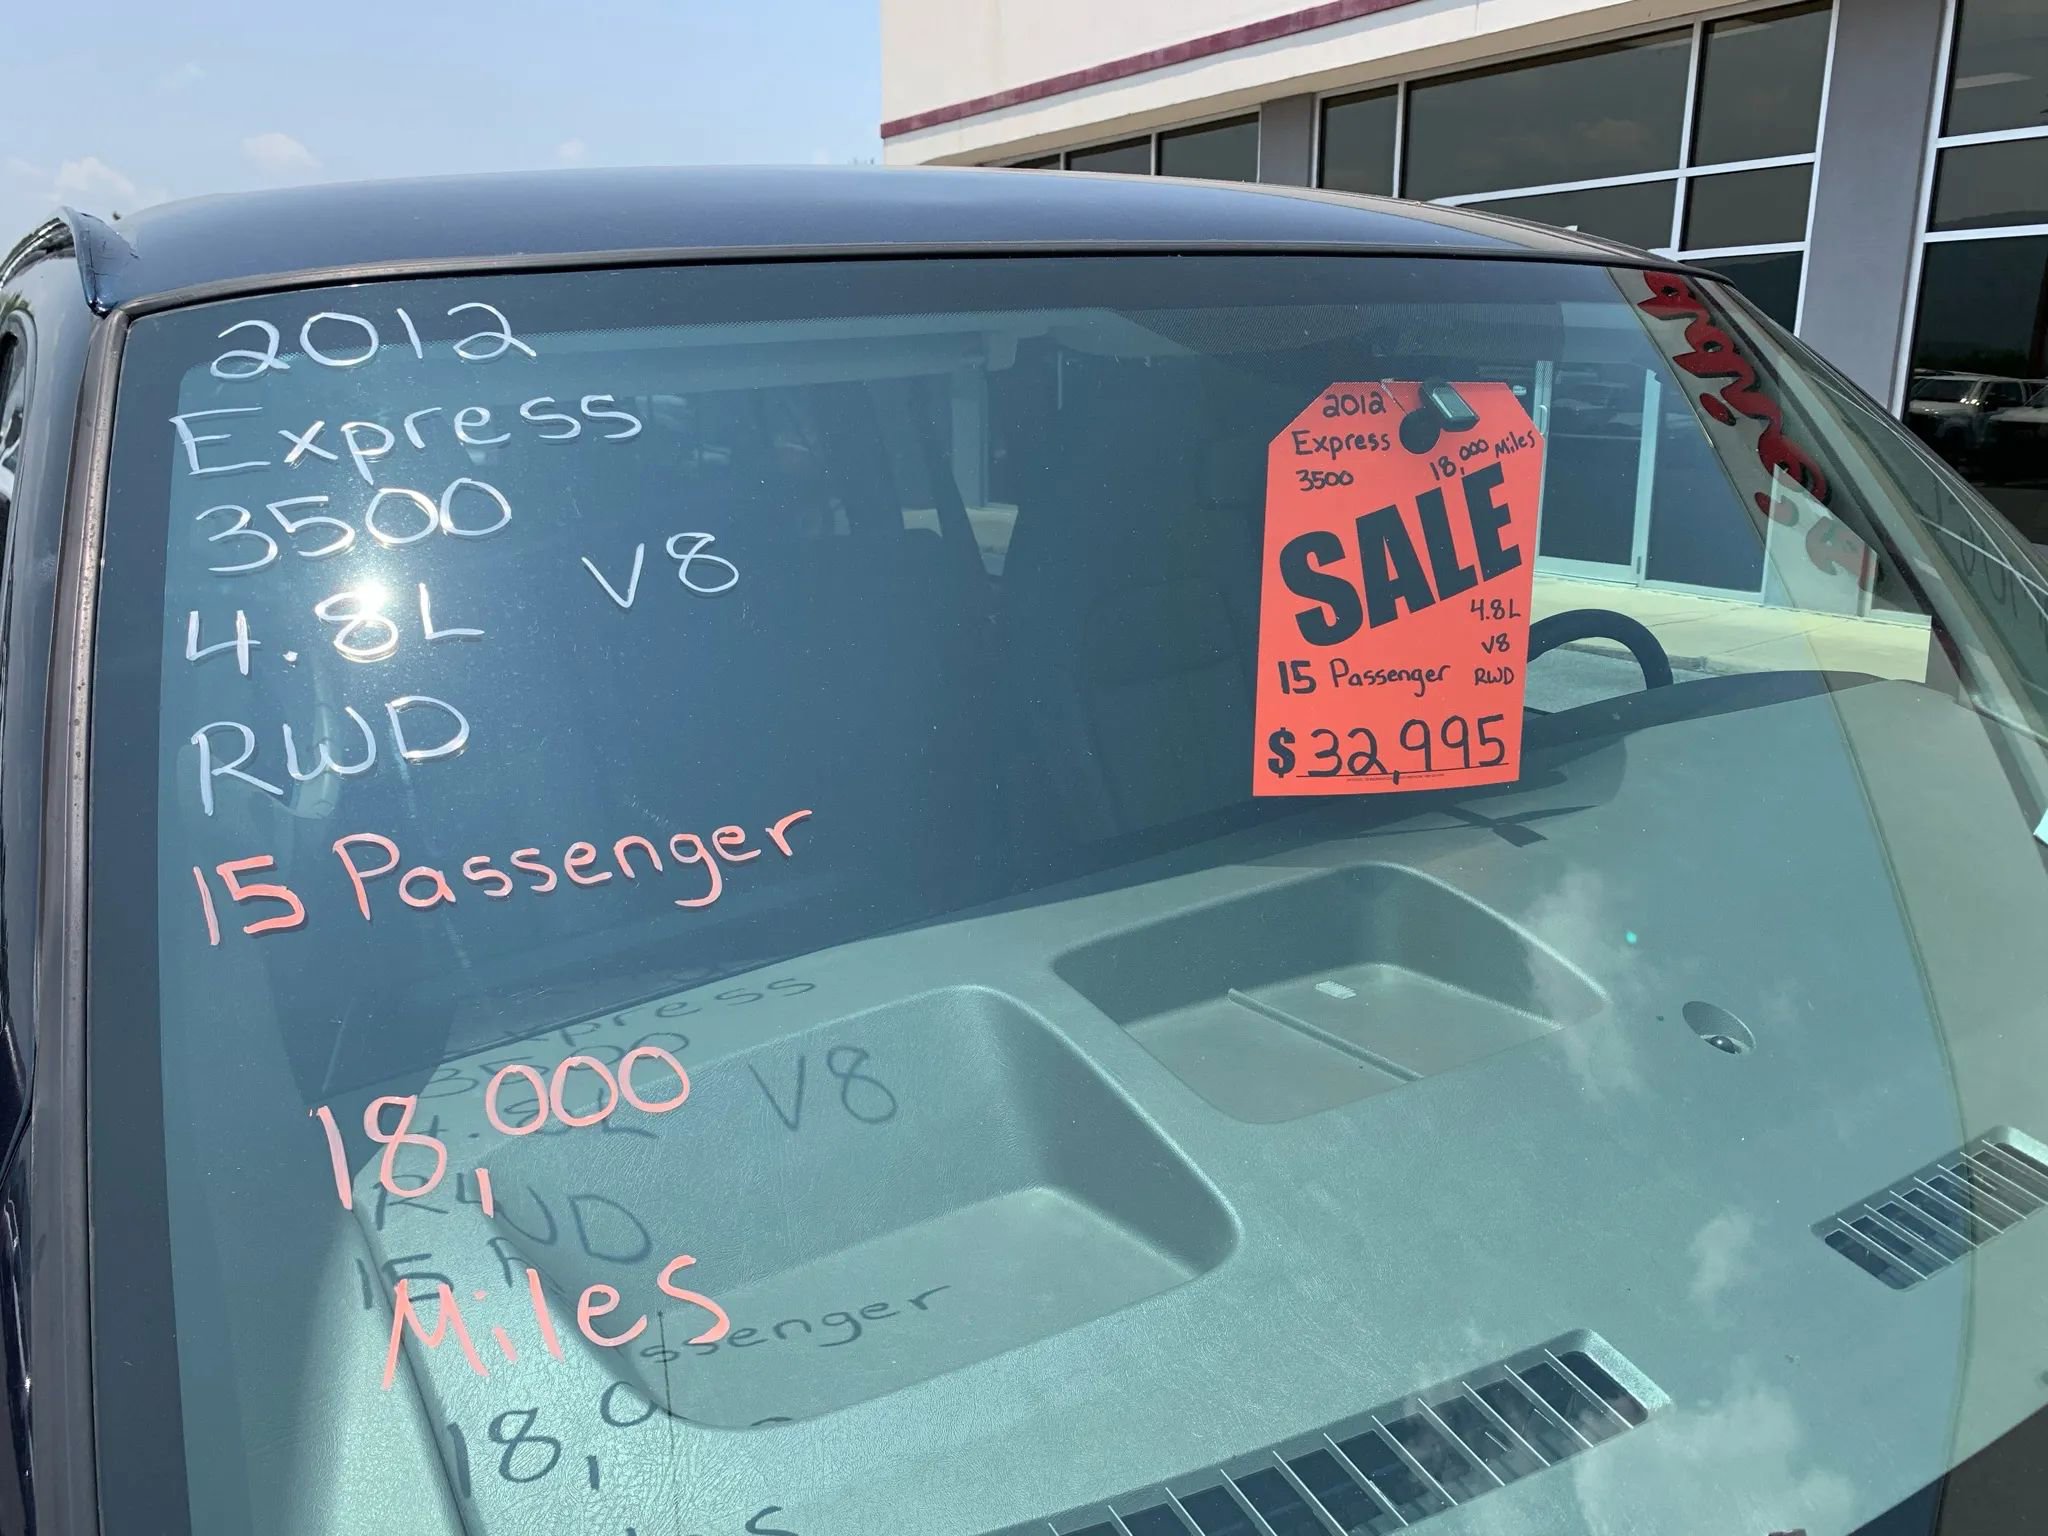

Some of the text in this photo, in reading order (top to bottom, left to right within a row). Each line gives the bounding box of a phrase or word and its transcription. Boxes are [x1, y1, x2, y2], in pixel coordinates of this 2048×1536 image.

[210, 302, 537, 379] 2012
[169, 394, 642, 485] Express
[1322, 390, 1387, 418] 2012
[1291, 430, 1391, 460] Express
[1296, 470, 1354, 492] 3500
[1429, 429, 1536, 480] 18,000 Miles
[196, 477, 512, 574] 3500
[1279, 461, 1523, 647] SALE
[185, 531, 739, 675] 4.8L V8
[1470, 599, 1521, 621] 4.8L
[1277, 658, 1451, 698] 15 Passenger
[1474, 667, 1515, 686] RWD
[1481, 633, 1511, 655] V8
[191, 695, 470, 816] RWD
[1267, 714, 1506, 786] $32,995
[194, 809, 812, 946] 15 Passenger
[749, 1046, 897, 1131] V8
[316, 1046, 691, 1218] 18,000
